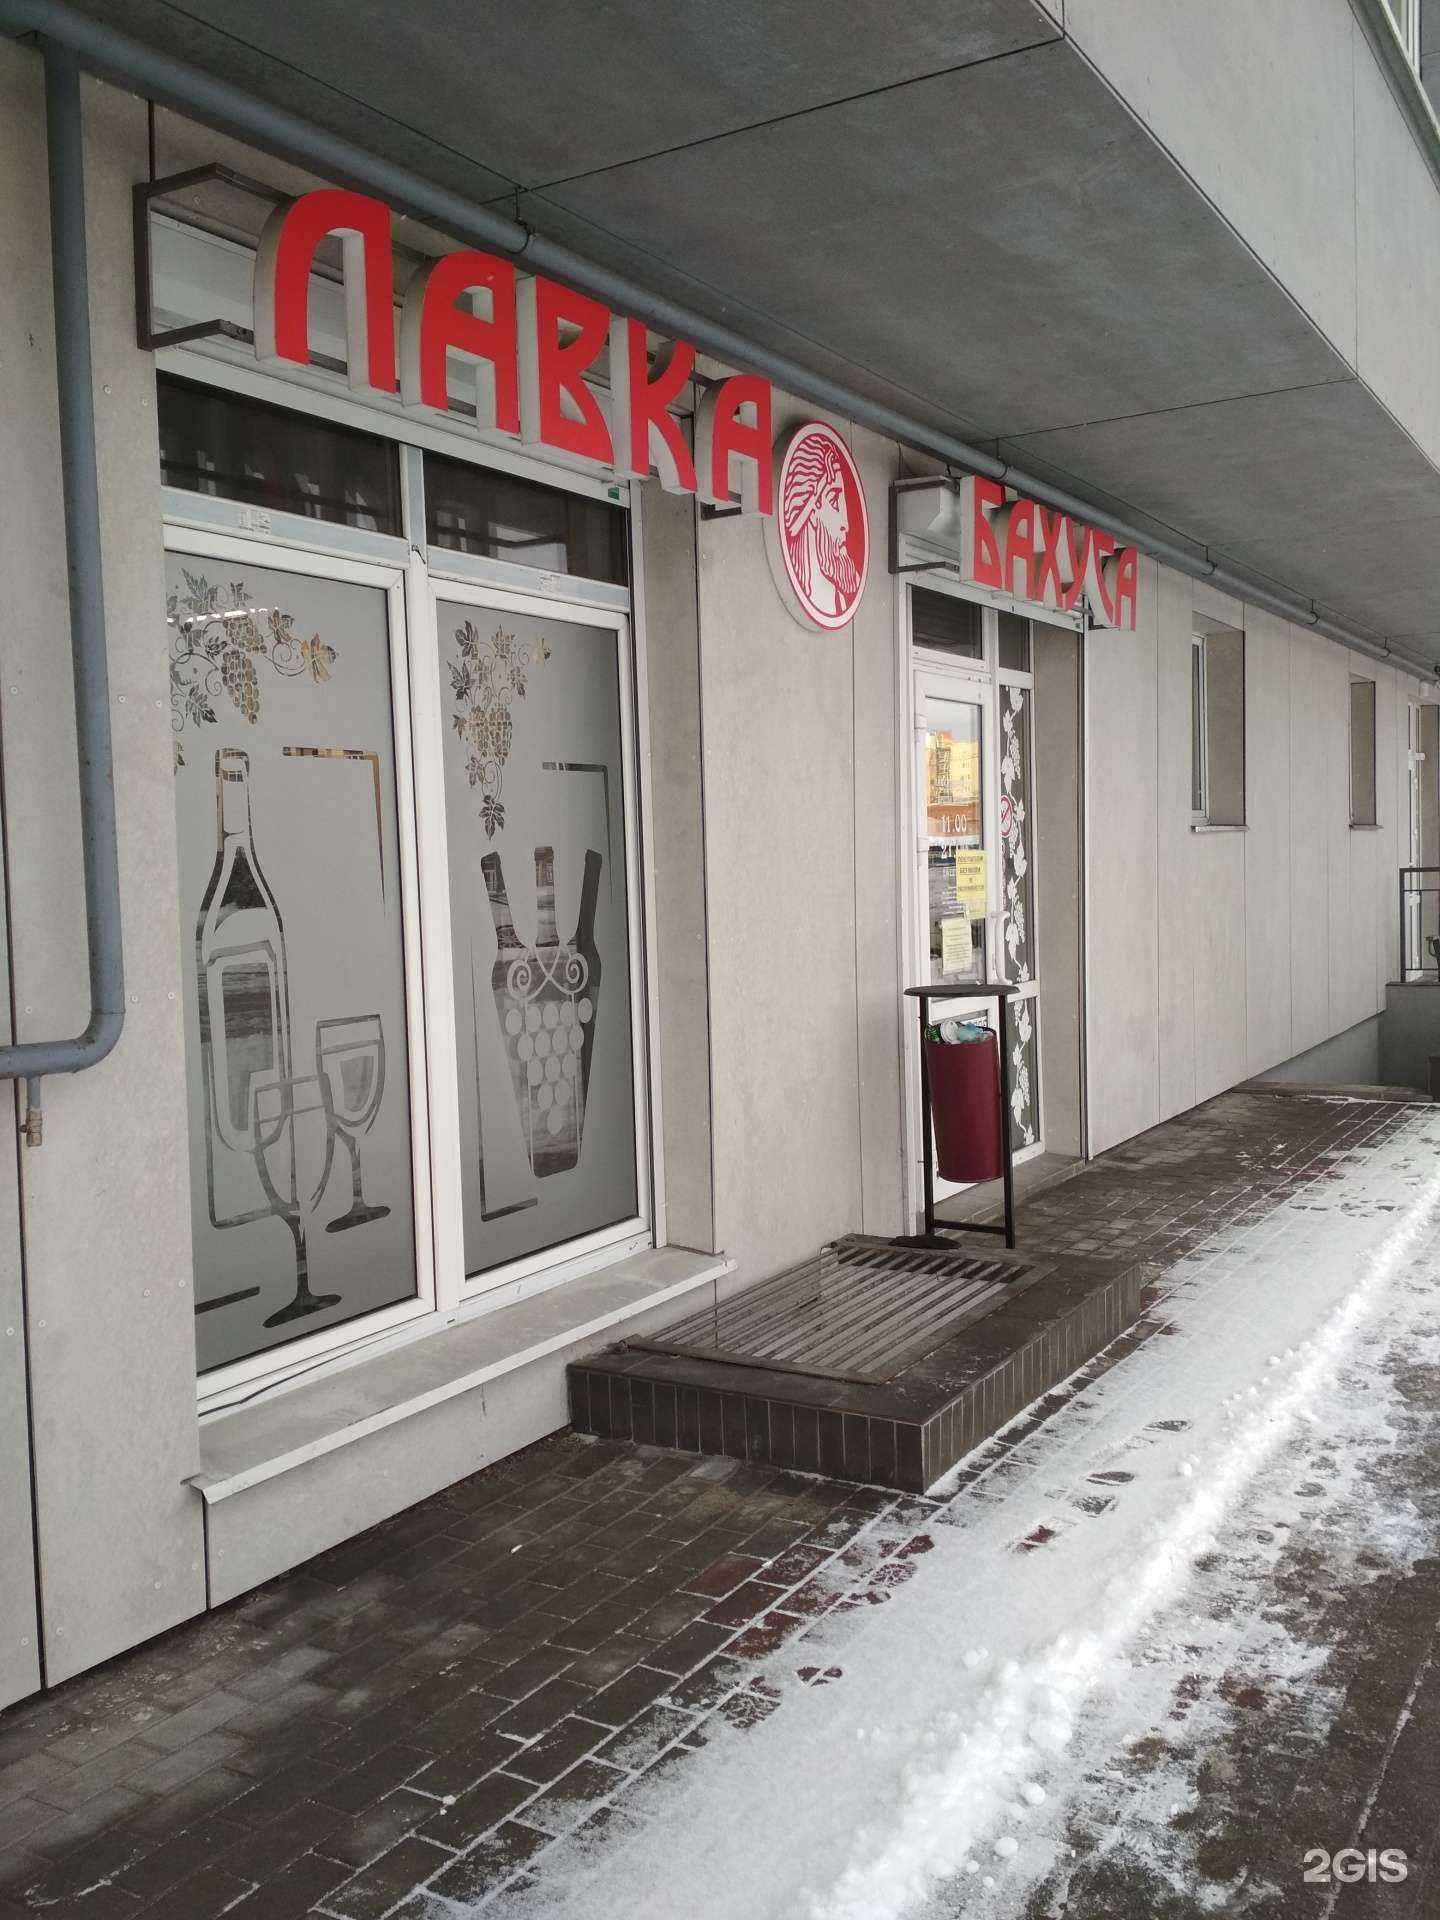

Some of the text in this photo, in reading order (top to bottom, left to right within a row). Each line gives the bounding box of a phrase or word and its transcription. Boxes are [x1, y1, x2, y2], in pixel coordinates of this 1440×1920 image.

[272, 188, 773, 516] ЛАВКА
[973, 475, 1138, 632] БАХУСА
[942, 814, 967, 833] 11.00
